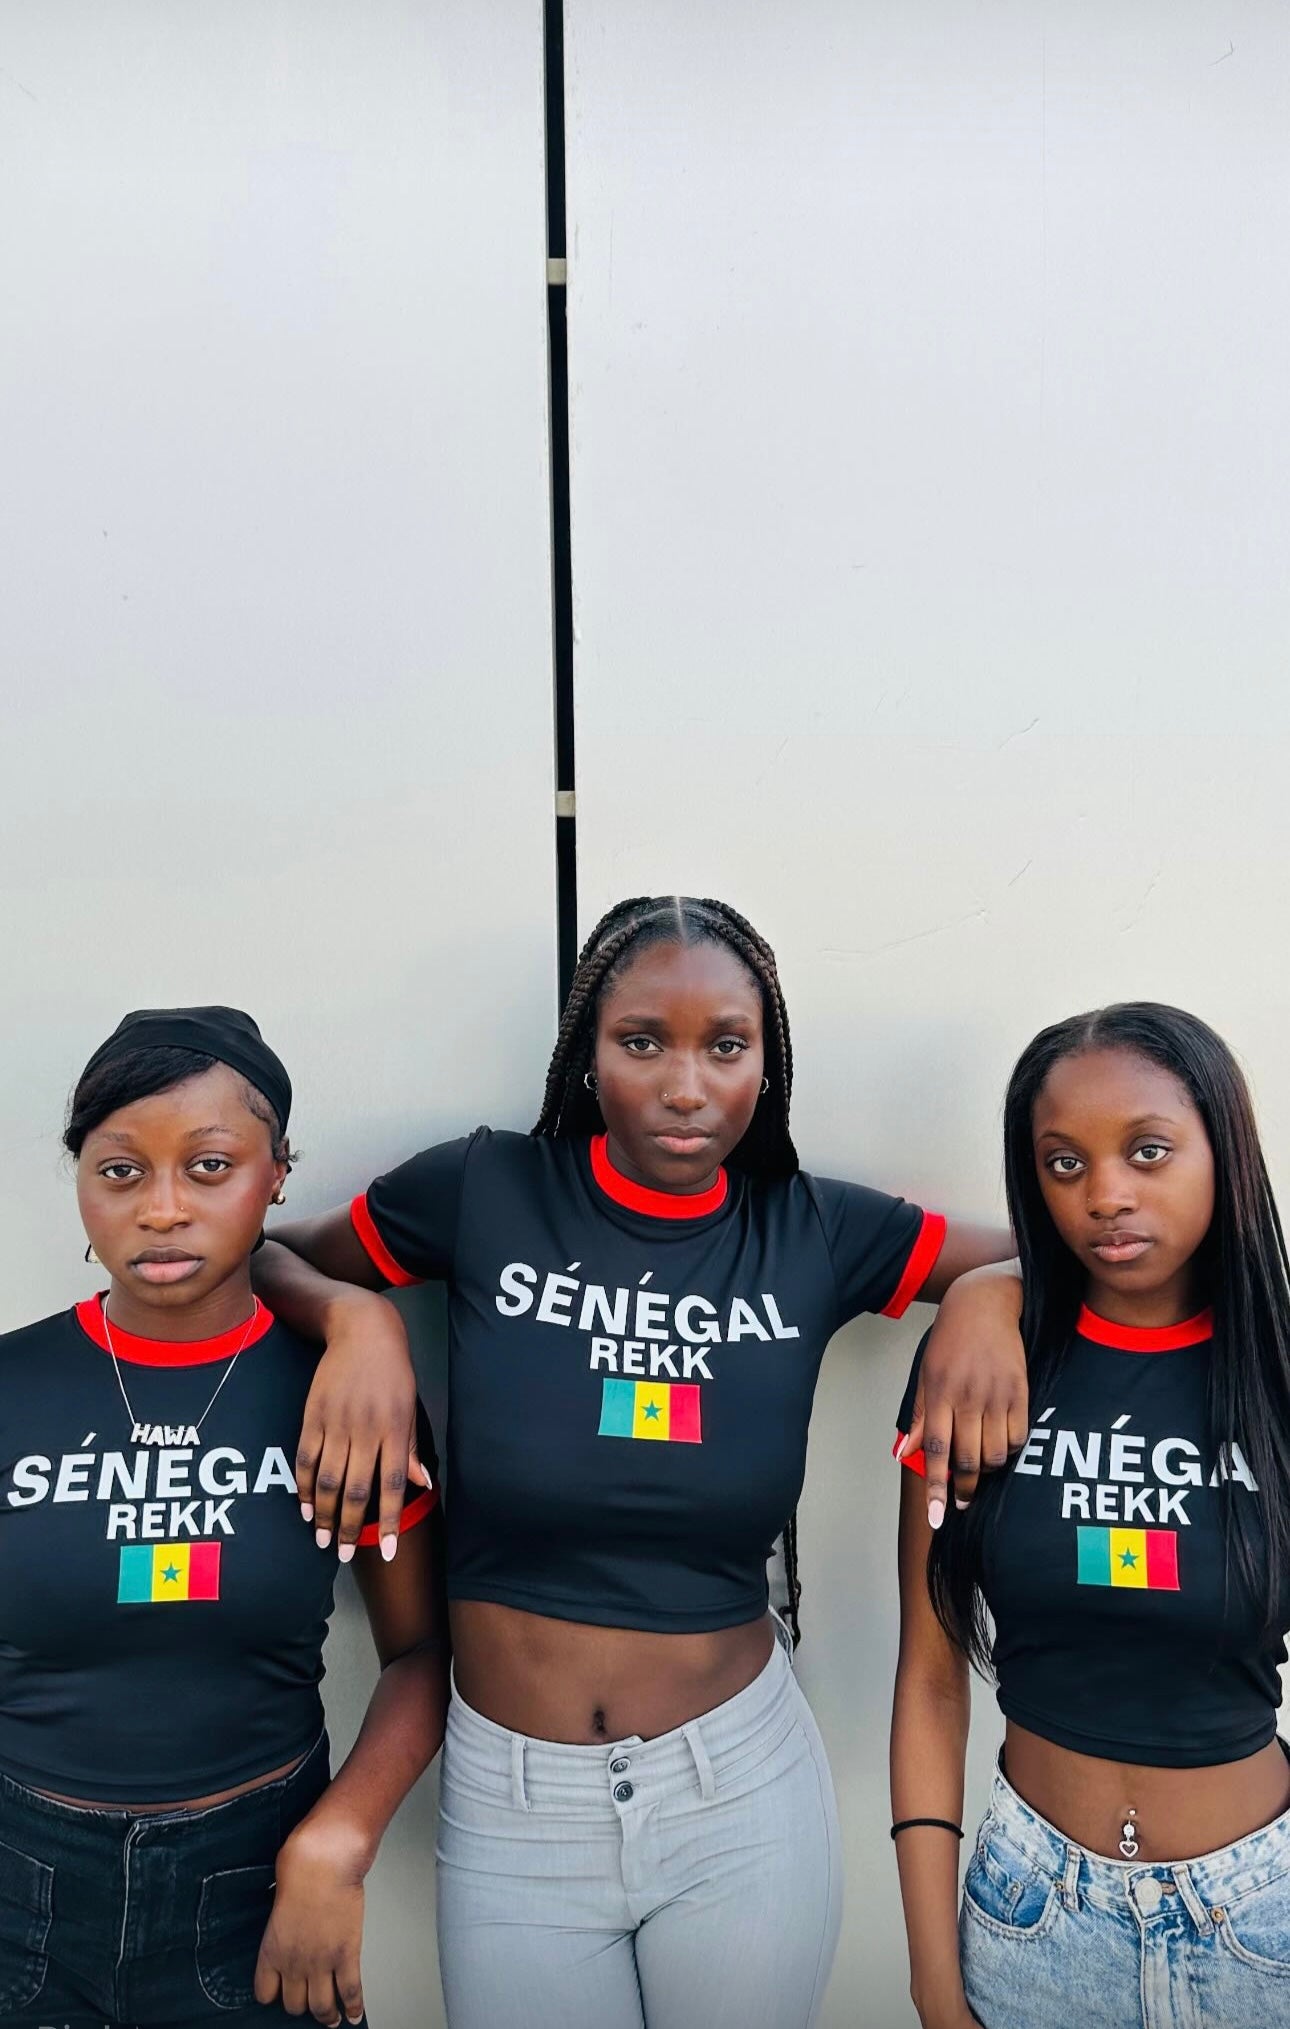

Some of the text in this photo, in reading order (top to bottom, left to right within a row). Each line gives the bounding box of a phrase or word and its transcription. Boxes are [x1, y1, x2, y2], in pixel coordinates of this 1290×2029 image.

[495, 1261, 800, 1343] SÉNÉGAL
[589, 1336, 714, 1380] REKK
[130, 1422, 201, 1447] HAWA
[1014, 1407, 1259, 1492] ÉNÉGA
[106, 1498, 236, 1540] REKK
[1061, 1482, 1192, 1526] REKK
